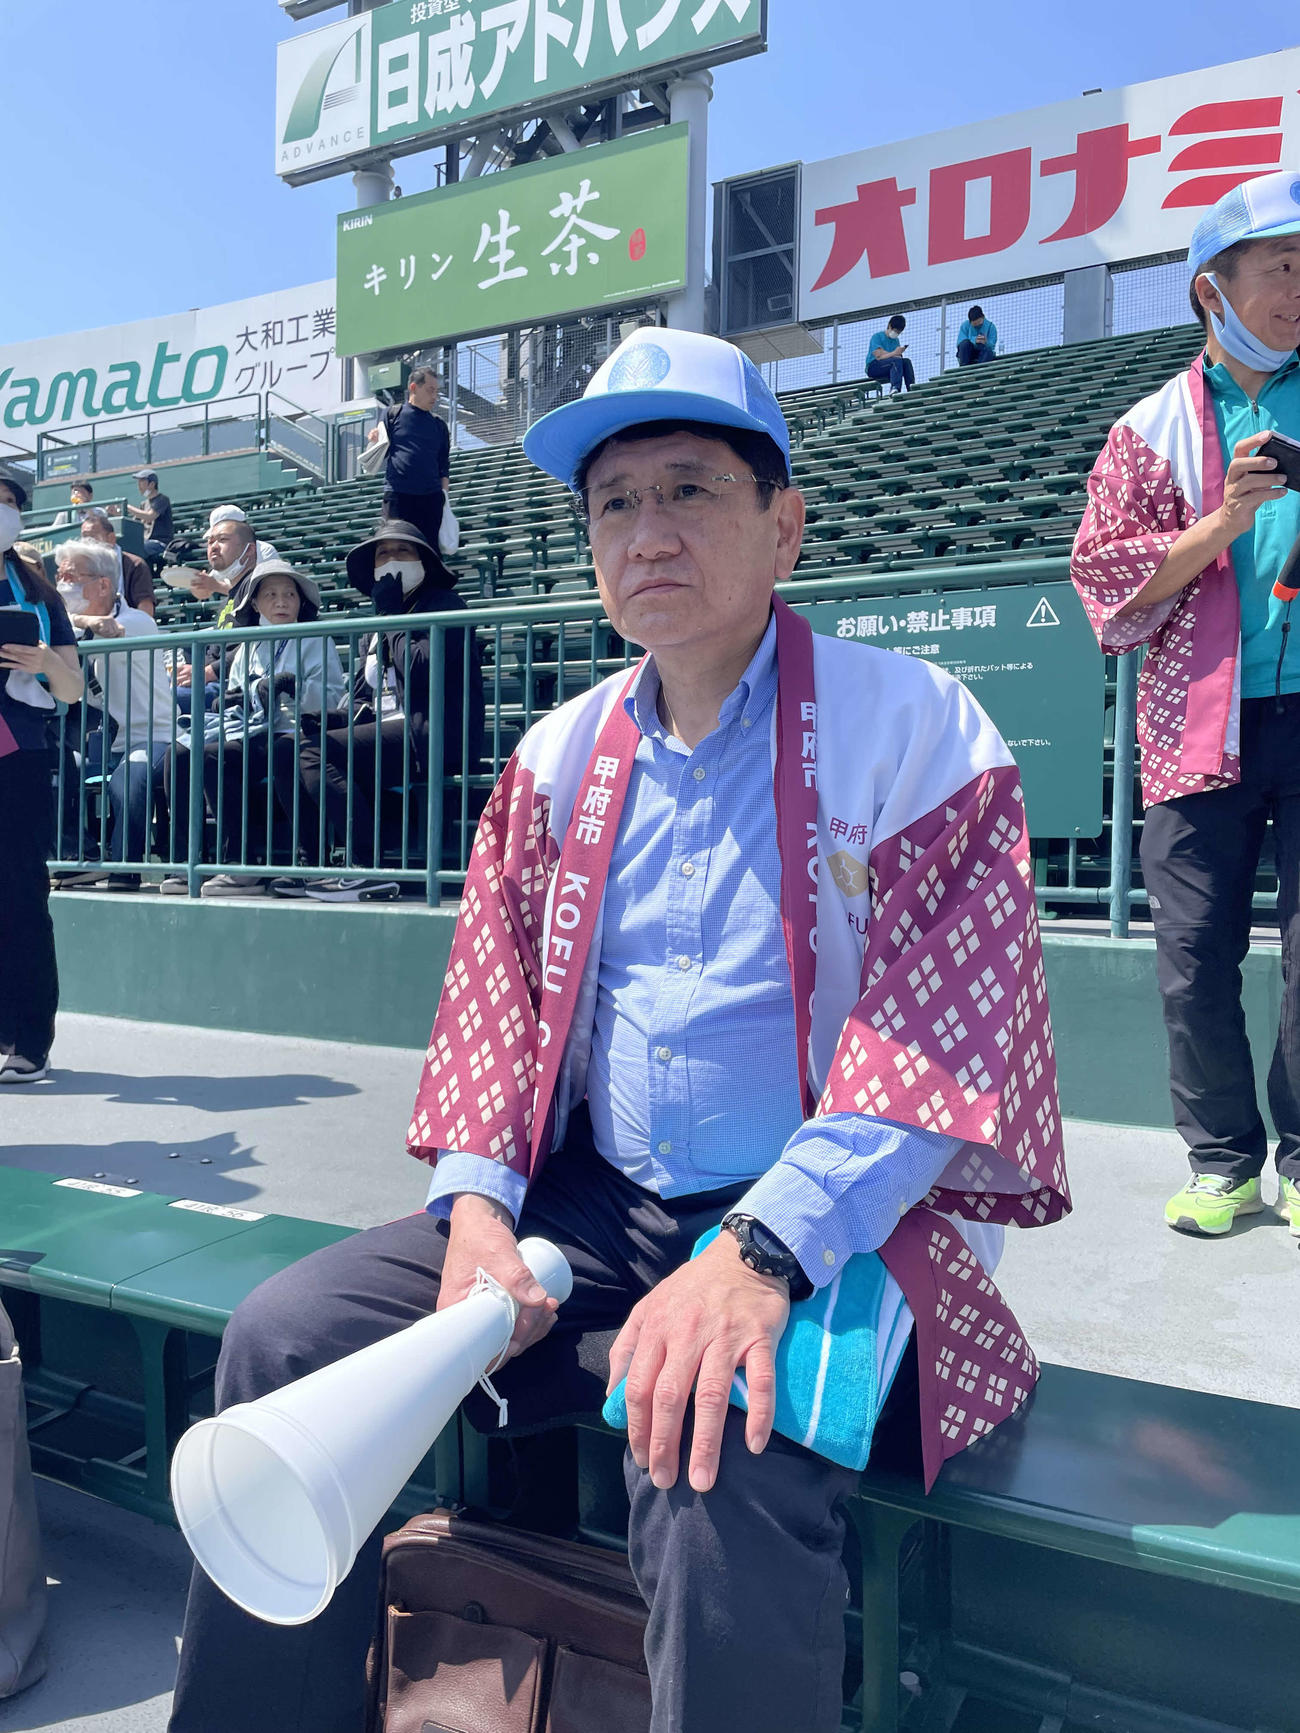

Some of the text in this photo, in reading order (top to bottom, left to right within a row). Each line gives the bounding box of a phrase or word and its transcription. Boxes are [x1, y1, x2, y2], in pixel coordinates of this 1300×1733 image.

[410, 0, 473, 25] 投資型
[280, 126, 366, 162] ADVANCE
[809, 89, 1300, 293] オロナミ
[343, 214, 373, 232] KIRIN
[235, 306, 336, 355] 大和工業
[235, 346, 336, 395] グループ
[575, 755, 620, 846] 甲府市
[829, 816, 868, 846] 甲府
[542, 870, 590, 995] KOFU
